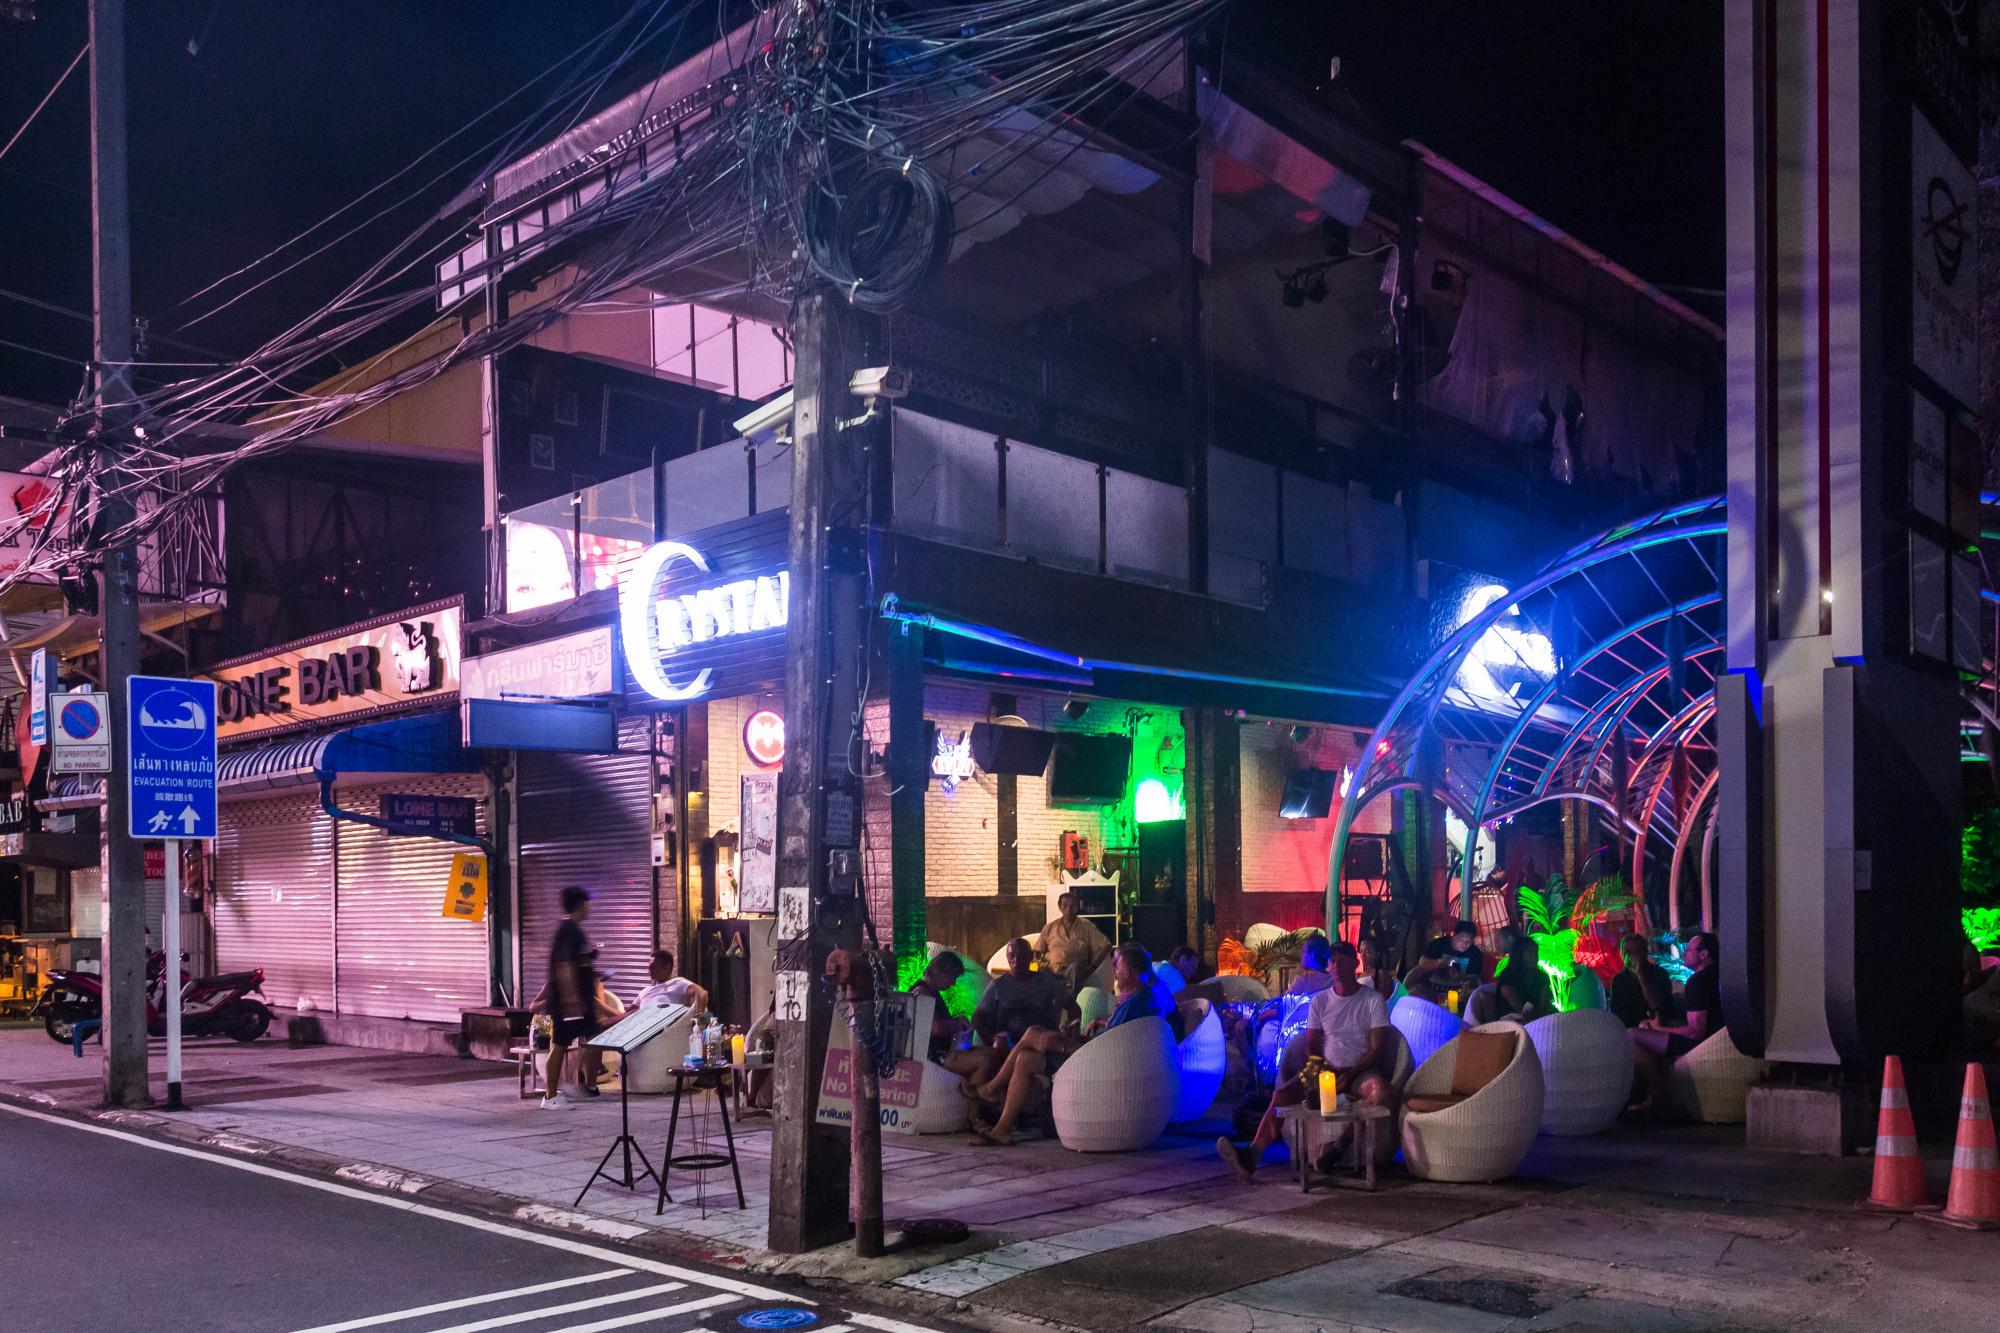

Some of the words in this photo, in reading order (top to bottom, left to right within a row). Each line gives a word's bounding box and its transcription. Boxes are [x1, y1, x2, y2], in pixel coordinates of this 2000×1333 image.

[218, 667, 284, 722] ONE
[298, 645, 374, 705] BAR
[74, 761, 101, 769] PARKING
[133, 753, 213, 773] เส้นทางหลบภัย
[133, 776, 184, 788] EVACUATION
[187, 778, 213, 789] ROUTE
[826, 1076, 847, 1093] No
